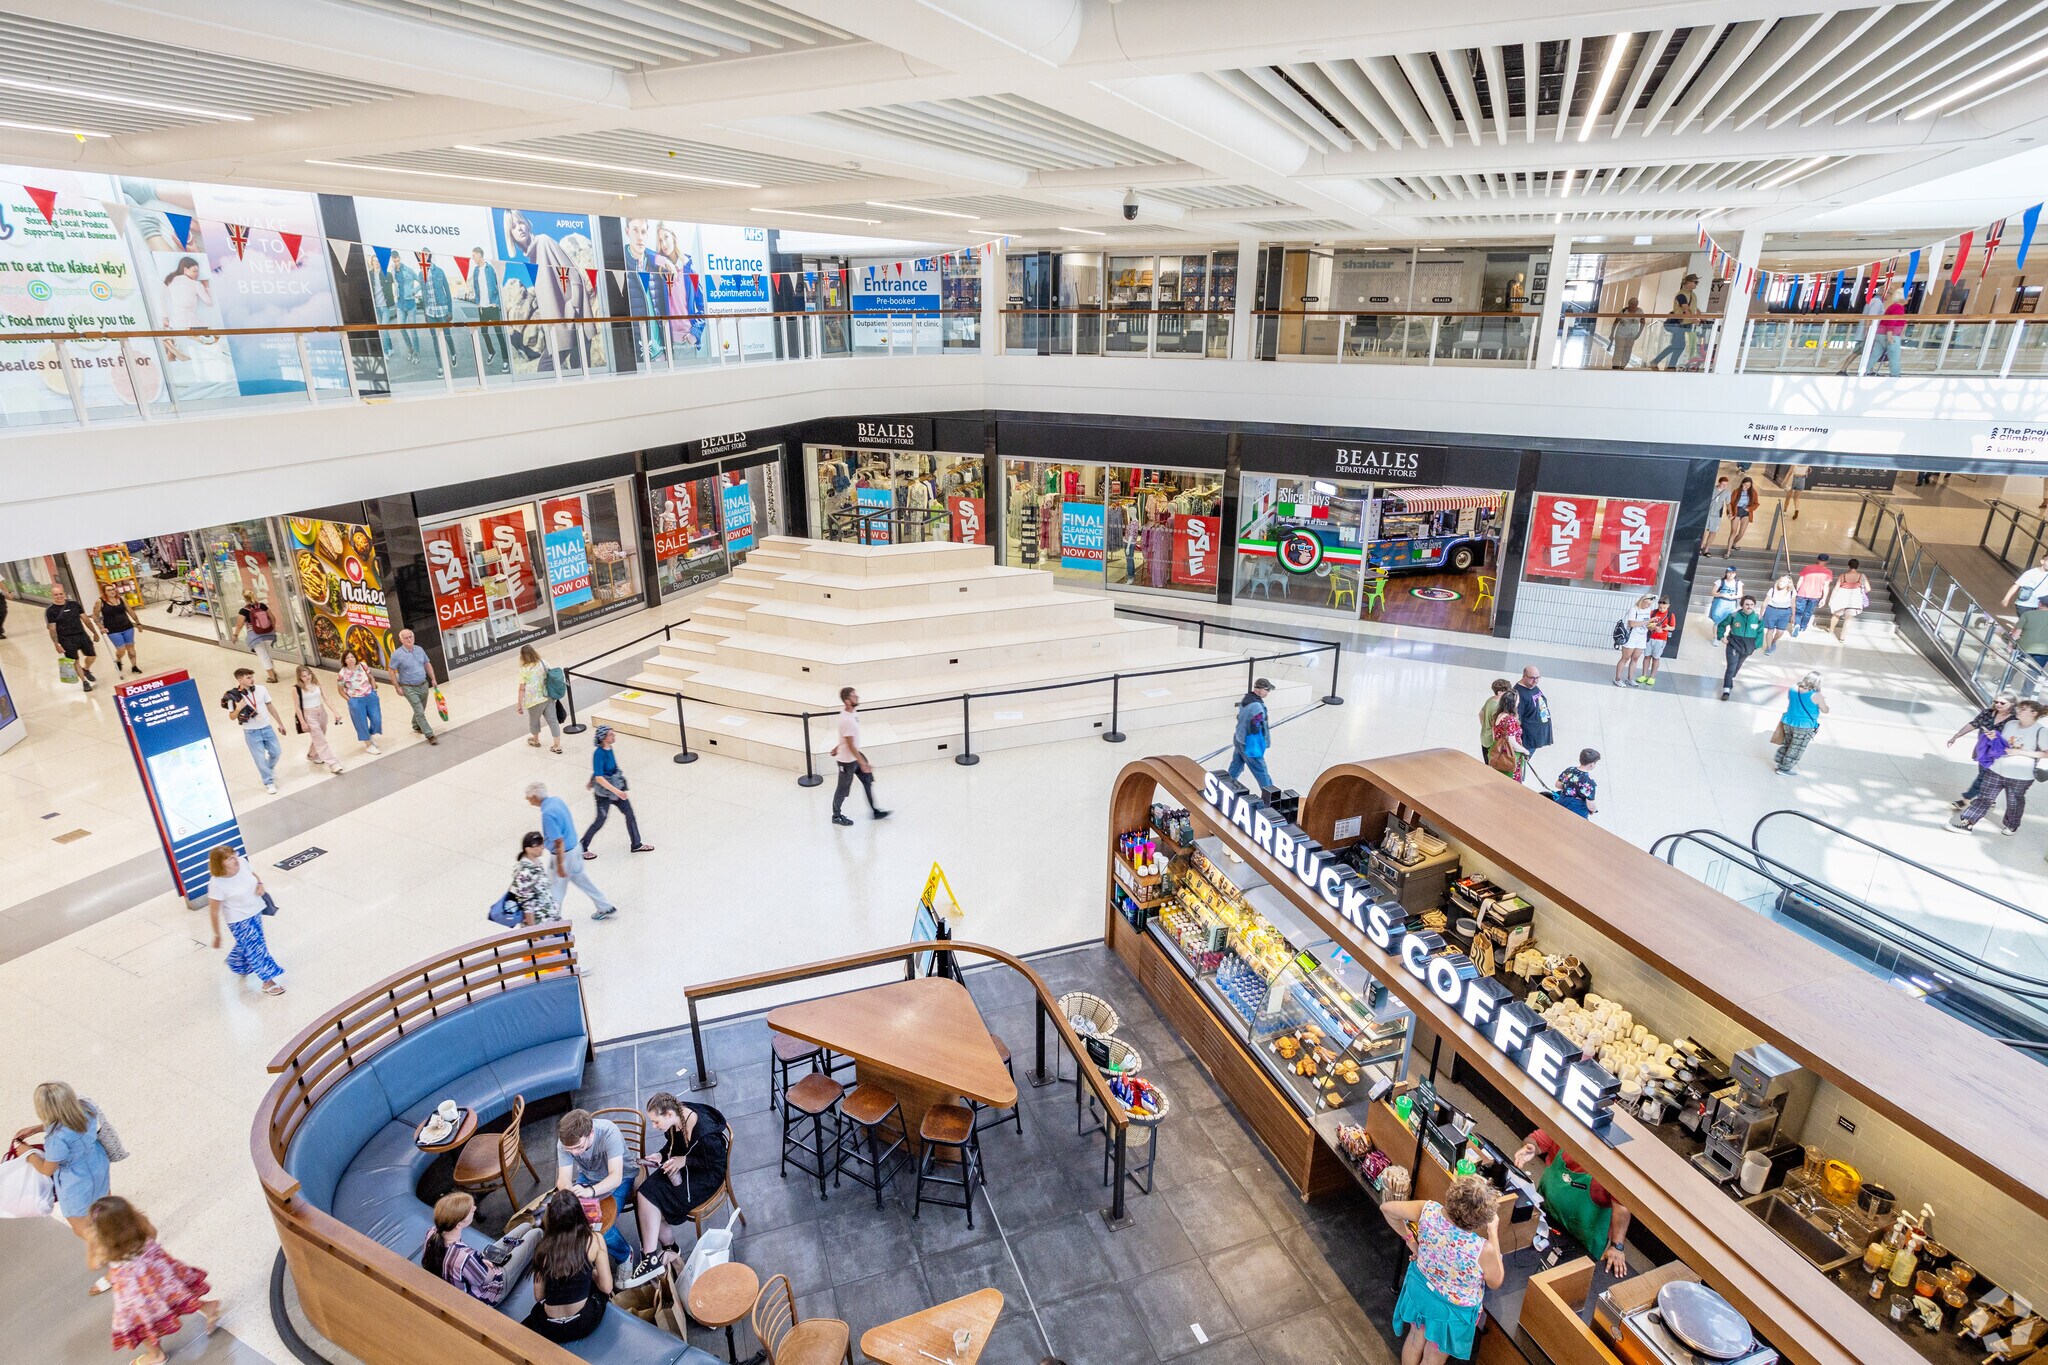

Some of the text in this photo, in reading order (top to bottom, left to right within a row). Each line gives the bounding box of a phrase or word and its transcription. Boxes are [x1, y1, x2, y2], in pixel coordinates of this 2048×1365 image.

[60, 208, 82, 217] Coffee
[60, 219, 79, 227] Local
[82, 220, 109, 230] Produce
[395, 223, 460, 236] JACK&JONES
[556, 219, 584, 230] APRICOT
[24, 227, 117, 240] Supporting Local Business
[745, 228, 763, 241] NHS
[12, 259, 127, 279] to eat the Naked Way!
[249, 260, 292, 274] NEW
[707, 253, 763, 272] Entrance
[1343, 260, 1394, 269] shankar
[238, 280, 312, 295] BEDECK
[864, 278, 928, 292] Entrance
[876, 297, 916, 305] Pre-booked
[36, 315, 65, 326] menu
[67, 314, 95, 329] gives
[97, 315, 117, 329] you
[119, 314, 136, 325] the
[72, 358, 93, 368] the
[858, 422, 914, 438] BEALES
[1755, 423, 1778, 432] Skills
[1789, 425, 1829, 434] Learning
[701, 432, 746, 449] BEALES
[1999, 434, 2044, 442] Climbing
[701, 441, 747, 456] DEPARTMENT STORES
[1336, 449, 1419, 469] BEALES
[1335, 465, 1385, 476] DEPARTMENT
[1281, 487, 1304, 504] Slice
[1307, 490, 1330, 508] Guys
[1062, 513, 1103, 529] FINAL
[741, 526, 752, 536] ON
[1062, 526, 1104, 536] CLEARANCE
[1550, 500, 1581, 567] SALE
[656, 533, 687, 554] SALE
[1062, 533, 1104, 547] EVENT
[1618, 506, 1651, 574] SALE
[1062, 547, 1103, 559] NOW ON
[1186, 518, 1211, 577] SALE
[574, 577, 589, 589] ON
[672, 570, 717, 591] Beales Poole
[439, 594, 486, 621] SALE
[562, 618, 573, 627] Shop
[579, 613, 590, 621] hours
[605, 597, 638, 612] www.beales.co.uk
[455, 656, 469, 665] Shop
[476, 650, 490, 658] hours
[494, 643, 502, 652] day
[507, 629, 547, 646] www.beales.co.uk
[126, 680, 164, 696] DOLPHIN
[150, 693, 160, 701] Park
[1203, 771, 1602, 1129] STARBUCKS COFFEE
